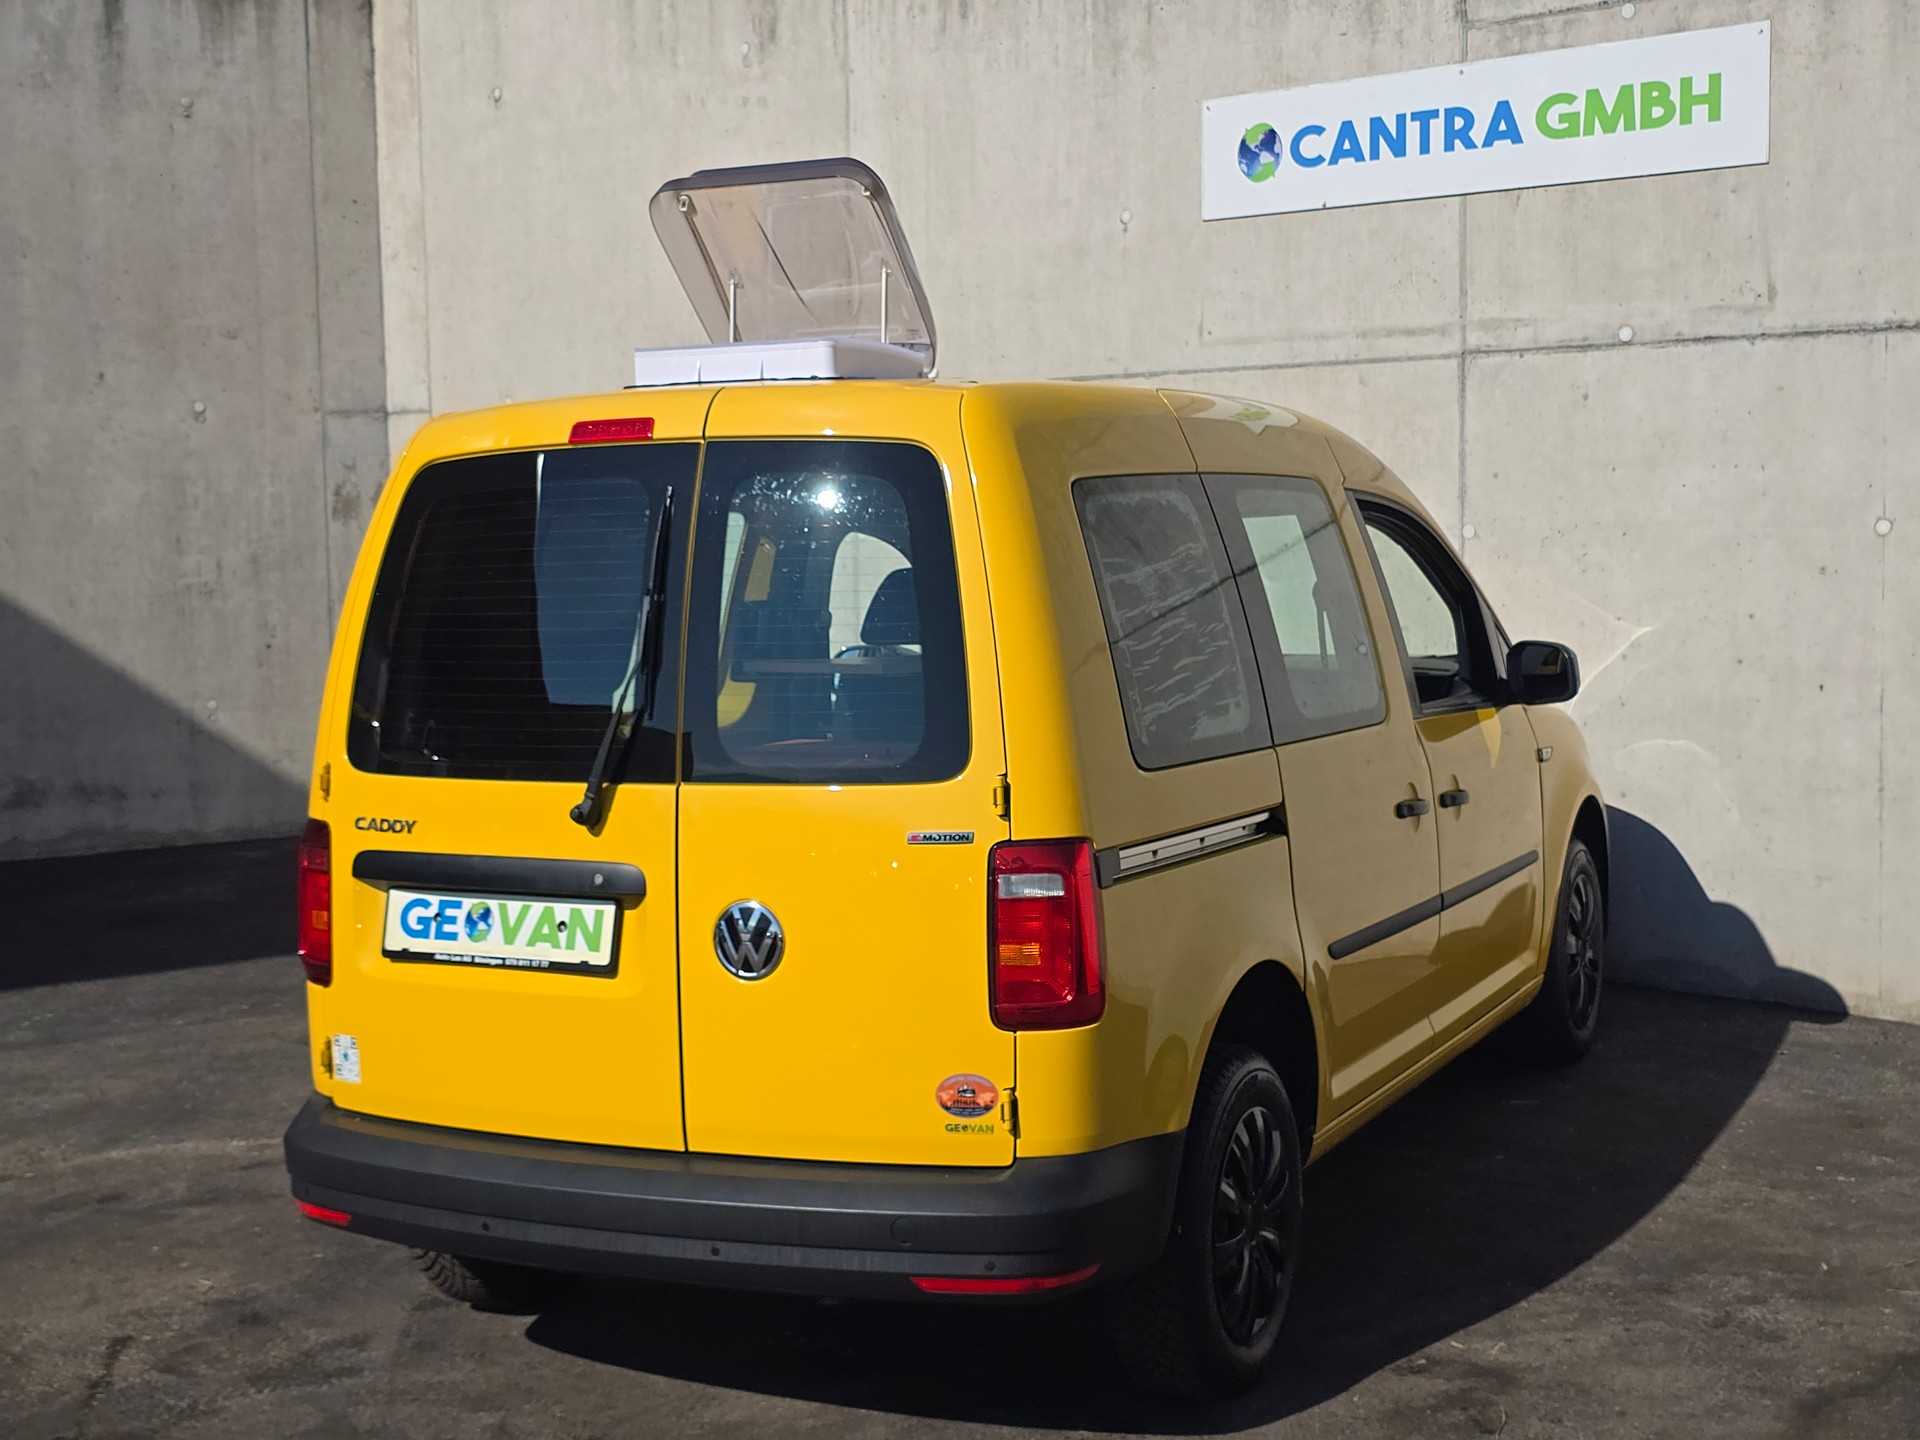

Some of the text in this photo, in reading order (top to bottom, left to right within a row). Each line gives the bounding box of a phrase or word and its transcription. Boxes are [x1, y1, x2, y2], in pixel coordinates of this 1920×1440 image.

[1289, 72, 1722, 169] CANTRA GMBH
[354, 816, 417, 834] CADDY
[400, 897, 604, 952] GEOVAN
[945, 1123, 994, 1135] GEOVAN
